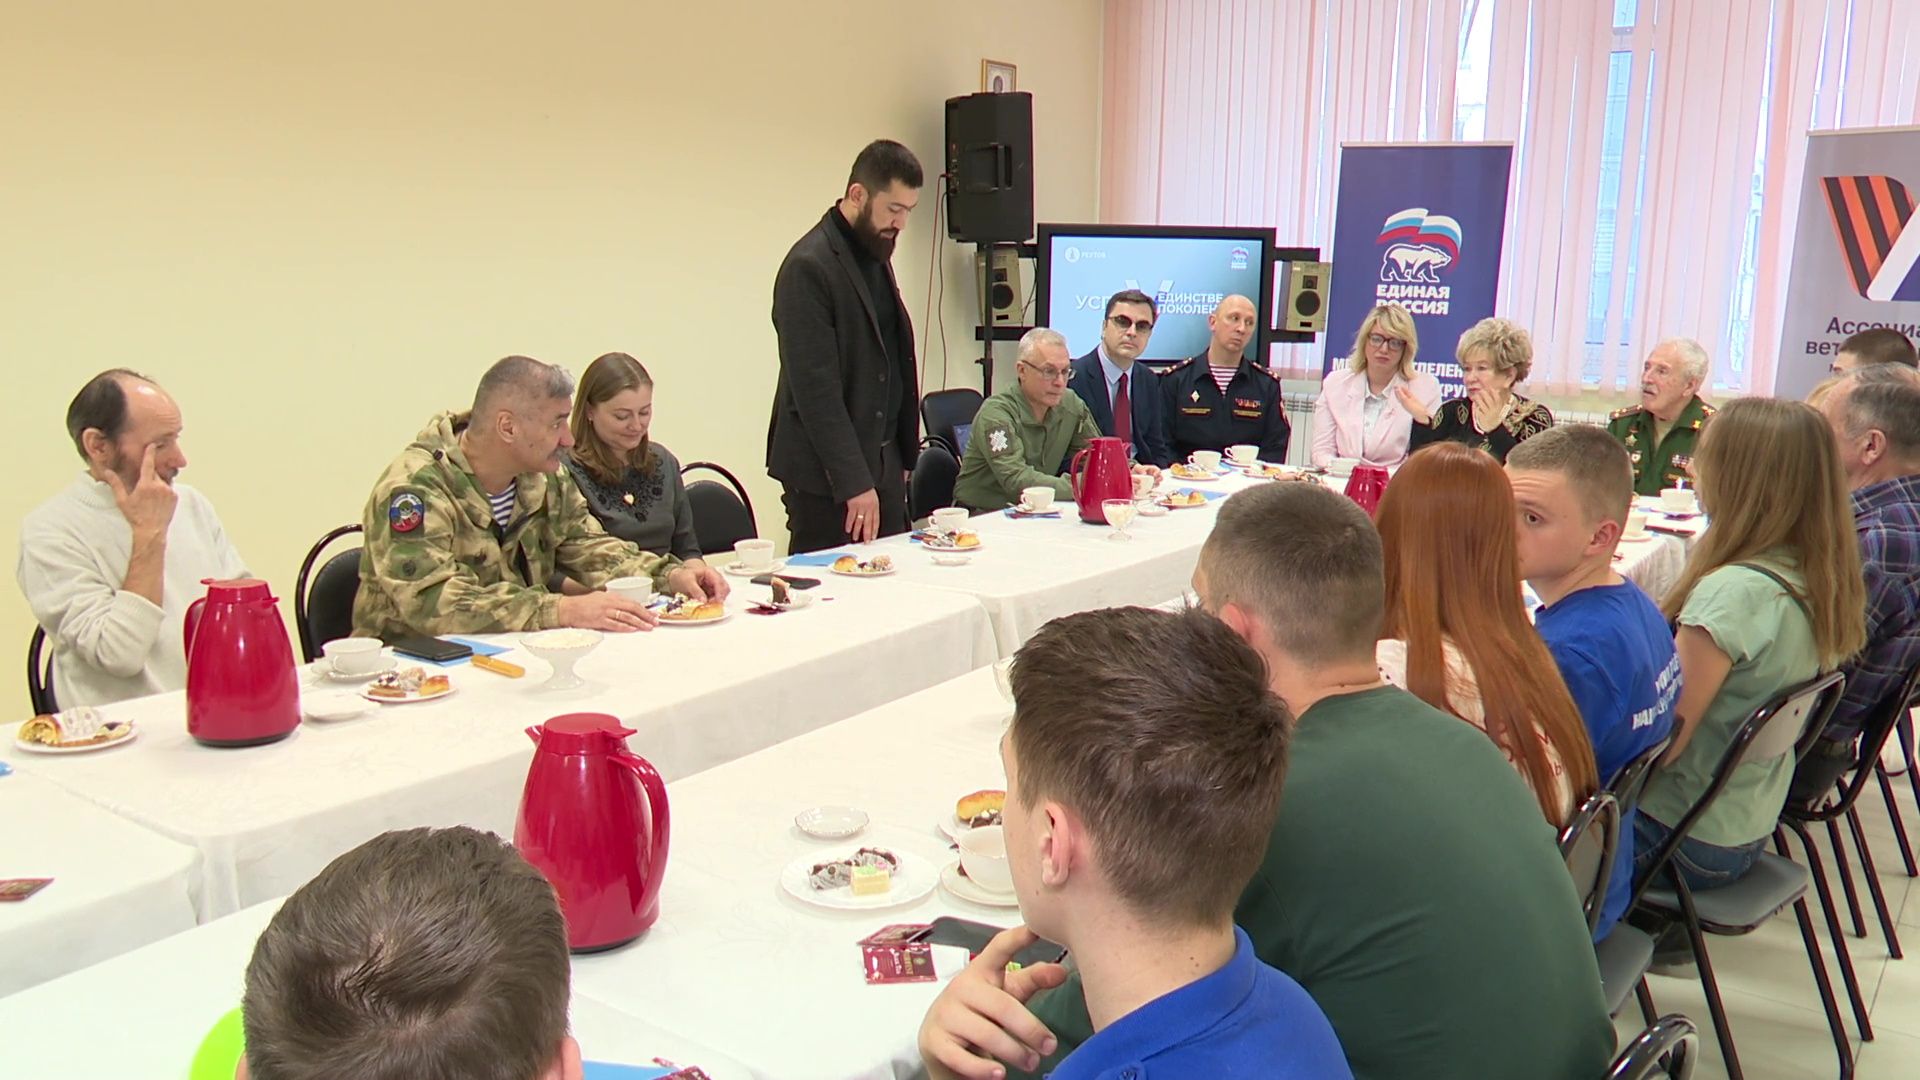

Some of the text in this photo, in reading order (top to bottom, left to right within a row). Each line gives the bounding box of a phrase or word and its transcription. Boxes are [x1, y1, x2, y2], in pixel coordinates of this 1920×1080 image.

[1376, 284, 1450, 299] ЕДИНАЯ
[1158, 292, 1224, 304] ЕДИНСТВЕ
[1158, 303, 1218, 314] ПОКОЛЕН
